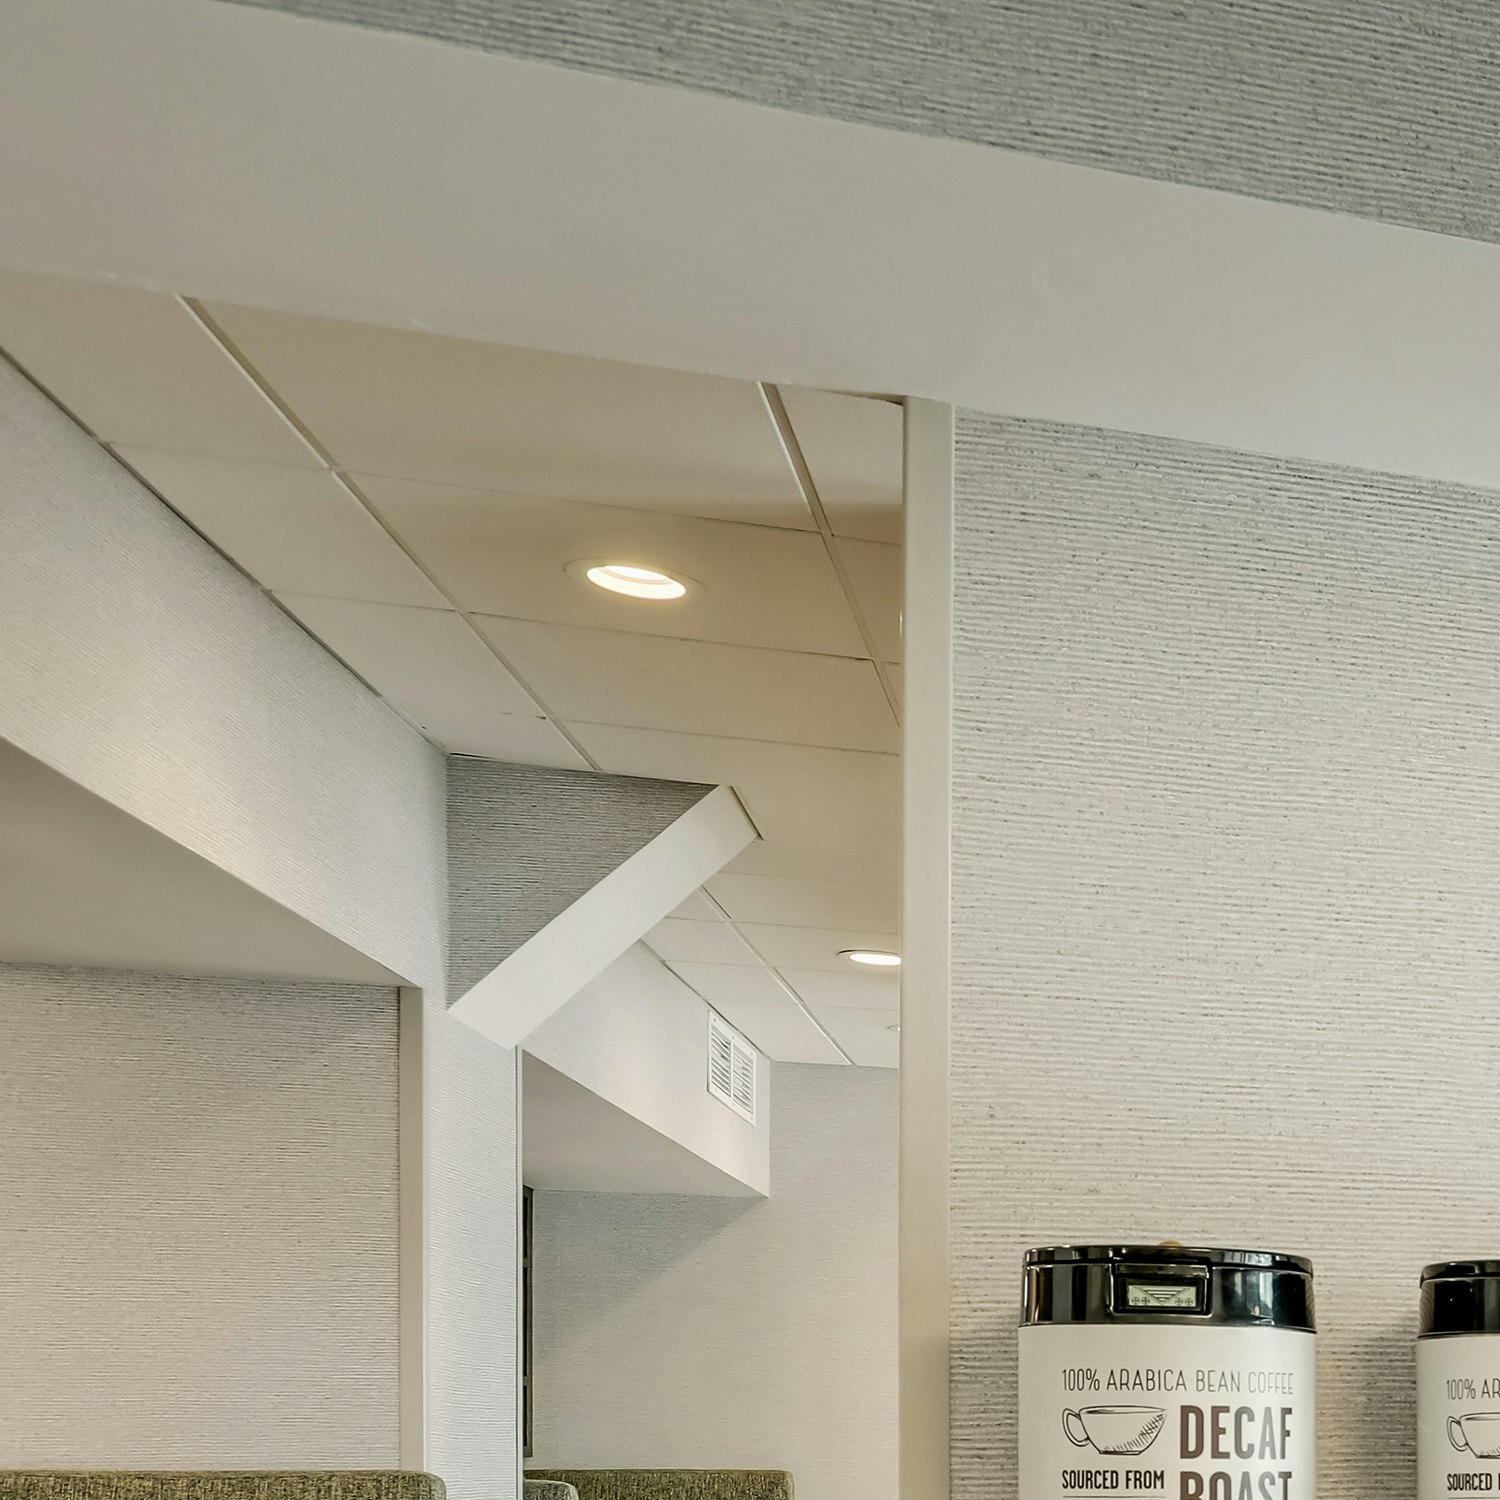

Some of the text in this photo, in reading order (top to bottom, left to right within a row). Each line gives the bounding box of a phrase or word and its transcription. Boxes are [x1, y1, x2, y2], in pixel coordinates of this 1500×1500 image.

[1061, 1368, 1294, 1395] 100% ARABICA BEAN COFFEE
[1446, 1378, 1476, 1400] 100%
[1179, 1404, 1293, 1460] DECAF
[1061, 1469, 1165, 1490] SOURCED FROM
[1447, 1472, 1493, 1491] SOURCED
